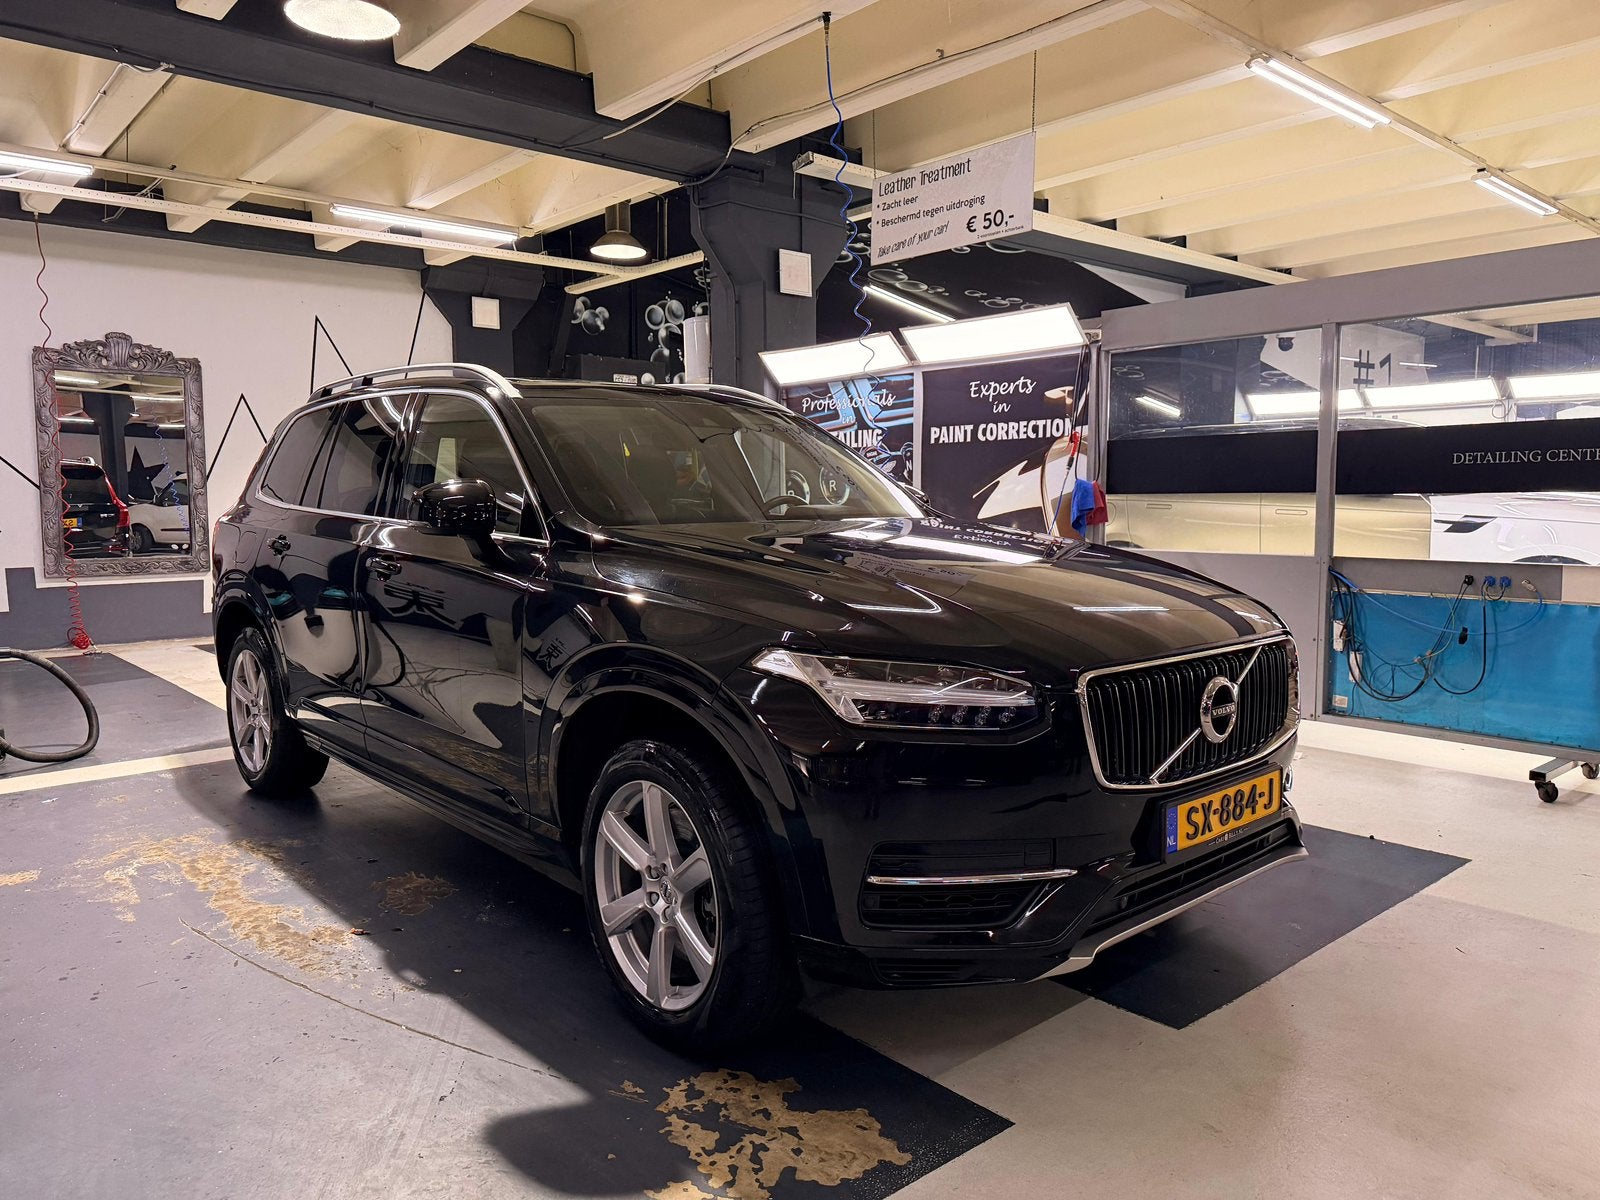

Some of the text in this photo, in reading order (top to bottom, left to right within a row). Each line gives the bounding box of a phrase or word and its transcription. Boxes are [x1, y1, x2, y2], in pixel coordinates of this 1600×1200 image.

[879, 158, 972, 197] Leather Treatment
[881, 195, 918, 211] Zacht leer
[881, 194, 986, 227] Beschermd tegen uitdroging
[966, 215, 977, 233] €
[982, 209, 1015, 230] 50,-
[877, 244, 891, 258] Take
[891, 239, 907, 252] care
[907, 234, 917, 249] of
[916, 229, 934, 248] your
[1353, 349, 1391, 389] #1
[801, 389, 896, 413] Professionals
[969, 375, 1037, 402] Experts
[993, 400, 1011, 413] in
[930, 418, 1072, 444] PAINT CORRECTION
[1452, 450, 1542, 464] DETAILING
[1212, 704, 1236, 716] VOLVO
[1186, 778, 1274, 841] SX-884-J
[1166, 835, 1177, 848] NL
